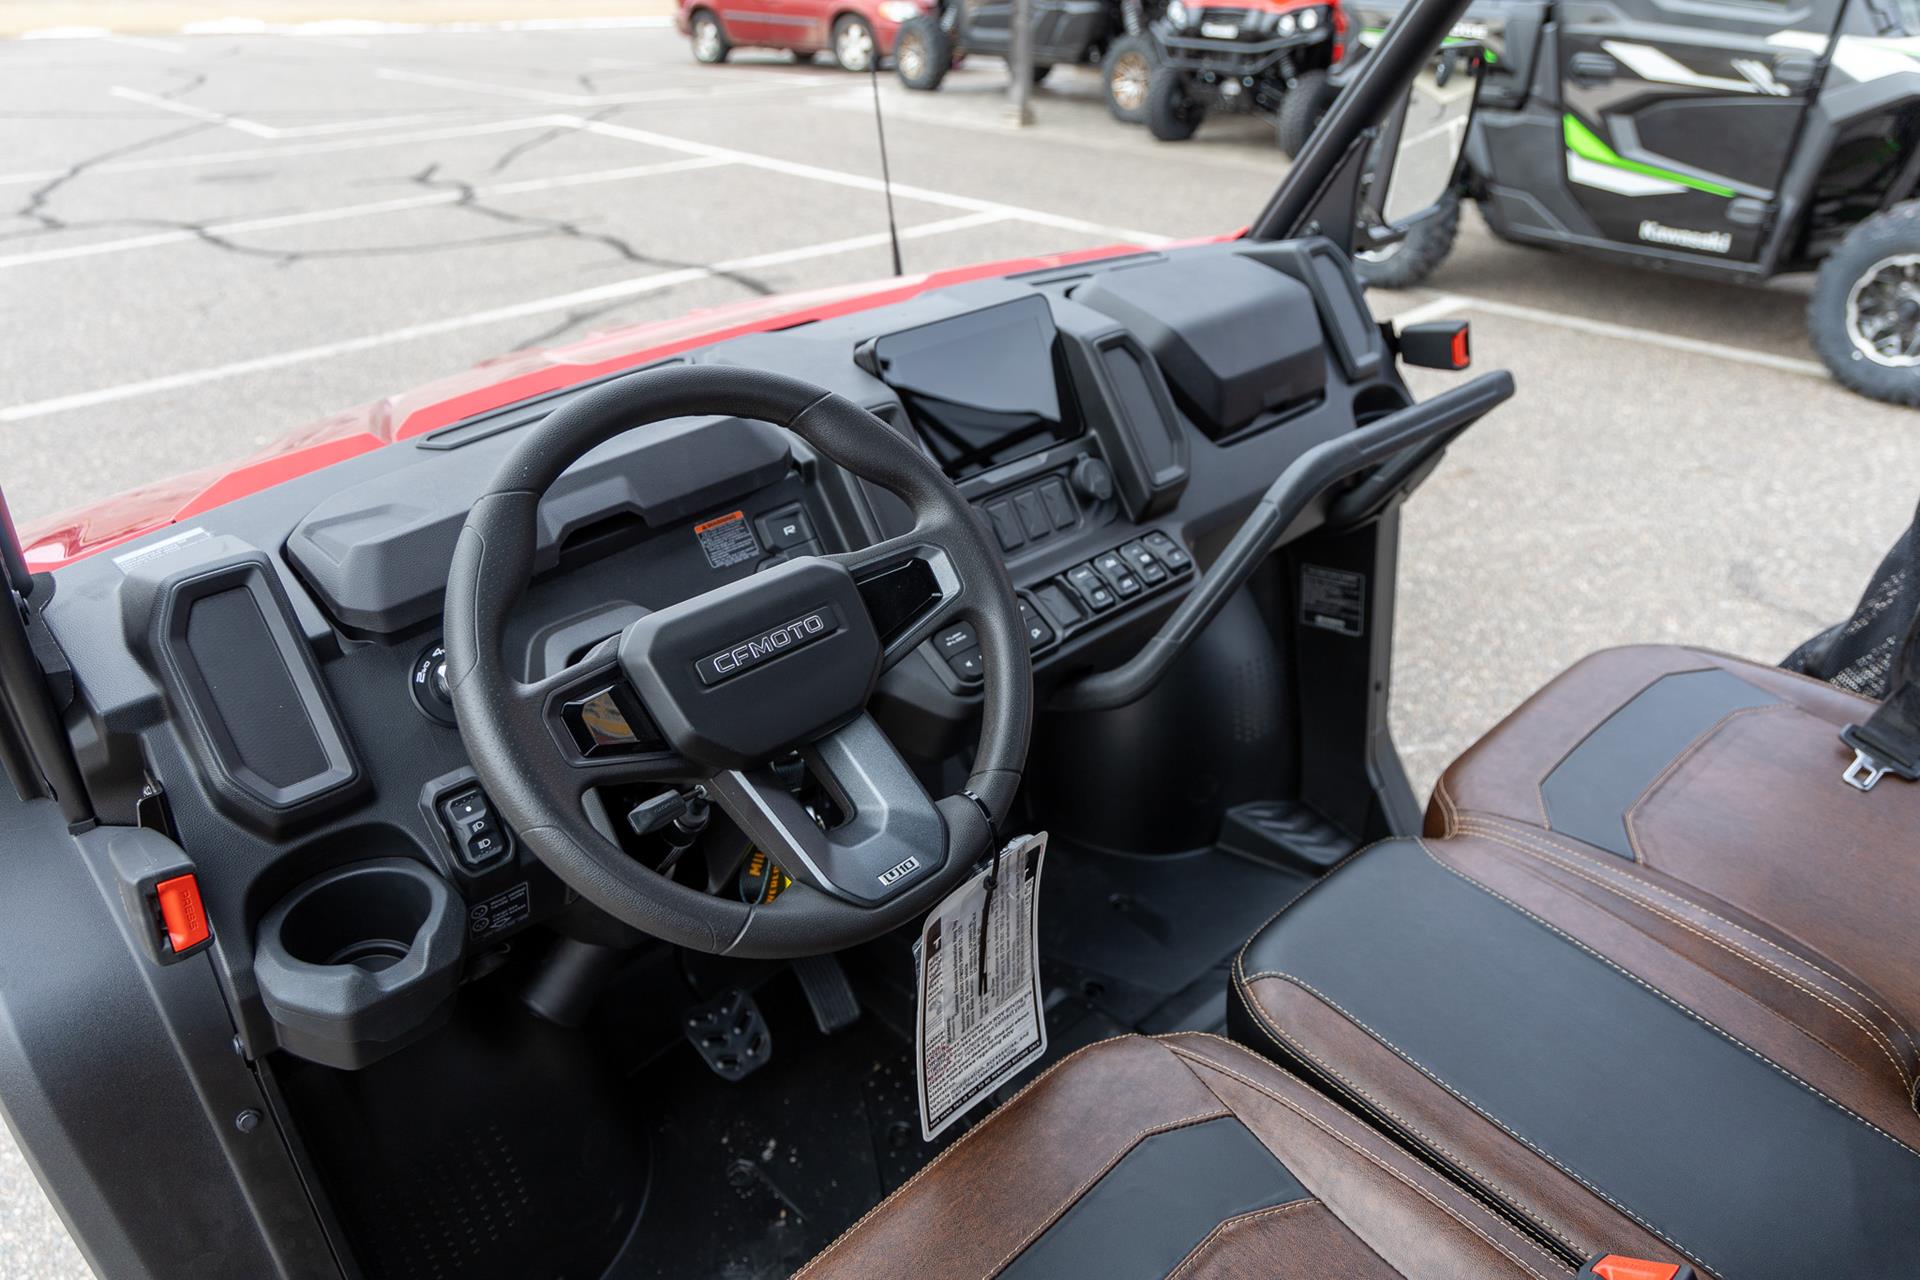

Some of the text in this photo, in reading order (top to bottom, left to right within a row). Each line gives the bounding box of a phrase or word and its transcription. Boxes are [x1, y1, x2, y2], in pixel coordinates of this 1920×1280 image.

[1638, 220, 1732, 253] Kawasaki
[783, 524, 796, 536] R
[713, 614, 824, 674] CFMOTO
[882, 858, 916, 883] U10
[183, 889, 199, 931] PRESS
